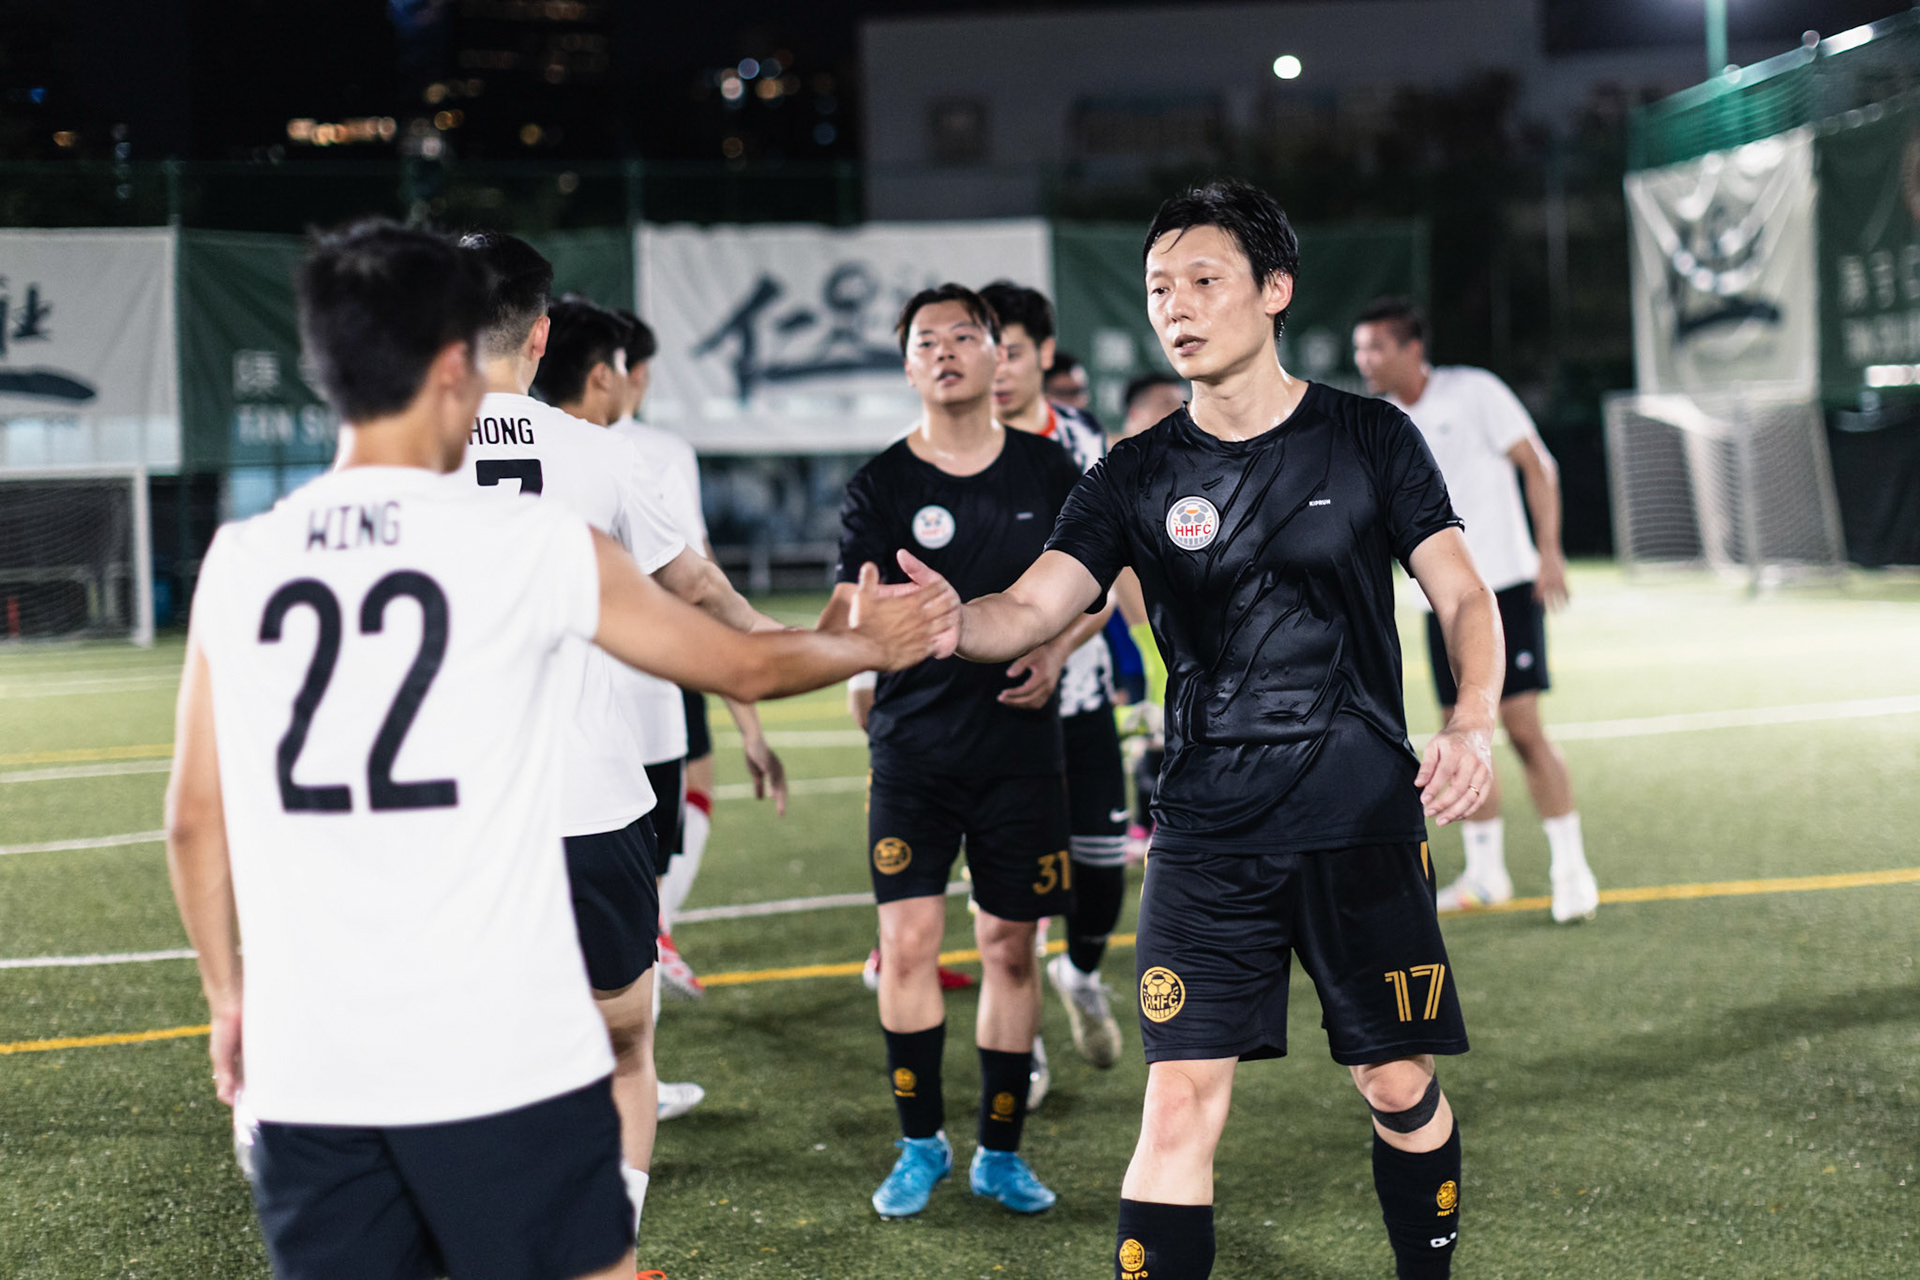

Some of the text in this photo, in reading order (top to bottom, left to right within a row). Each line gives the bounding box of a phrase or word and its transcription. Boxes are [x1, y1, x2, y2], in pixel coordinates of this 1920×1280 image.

[466, 417, 535, 445] HONG
[305, 500, 402, 551] WING
[1175, 524, 1211, 537] HHFC
[258, 568, 458, 815] 22
[1032, 850, 1071, 895] 31
[1144, 994, 1179, 1009] HHFC
[1384, 963, 1445, 1022] 17
